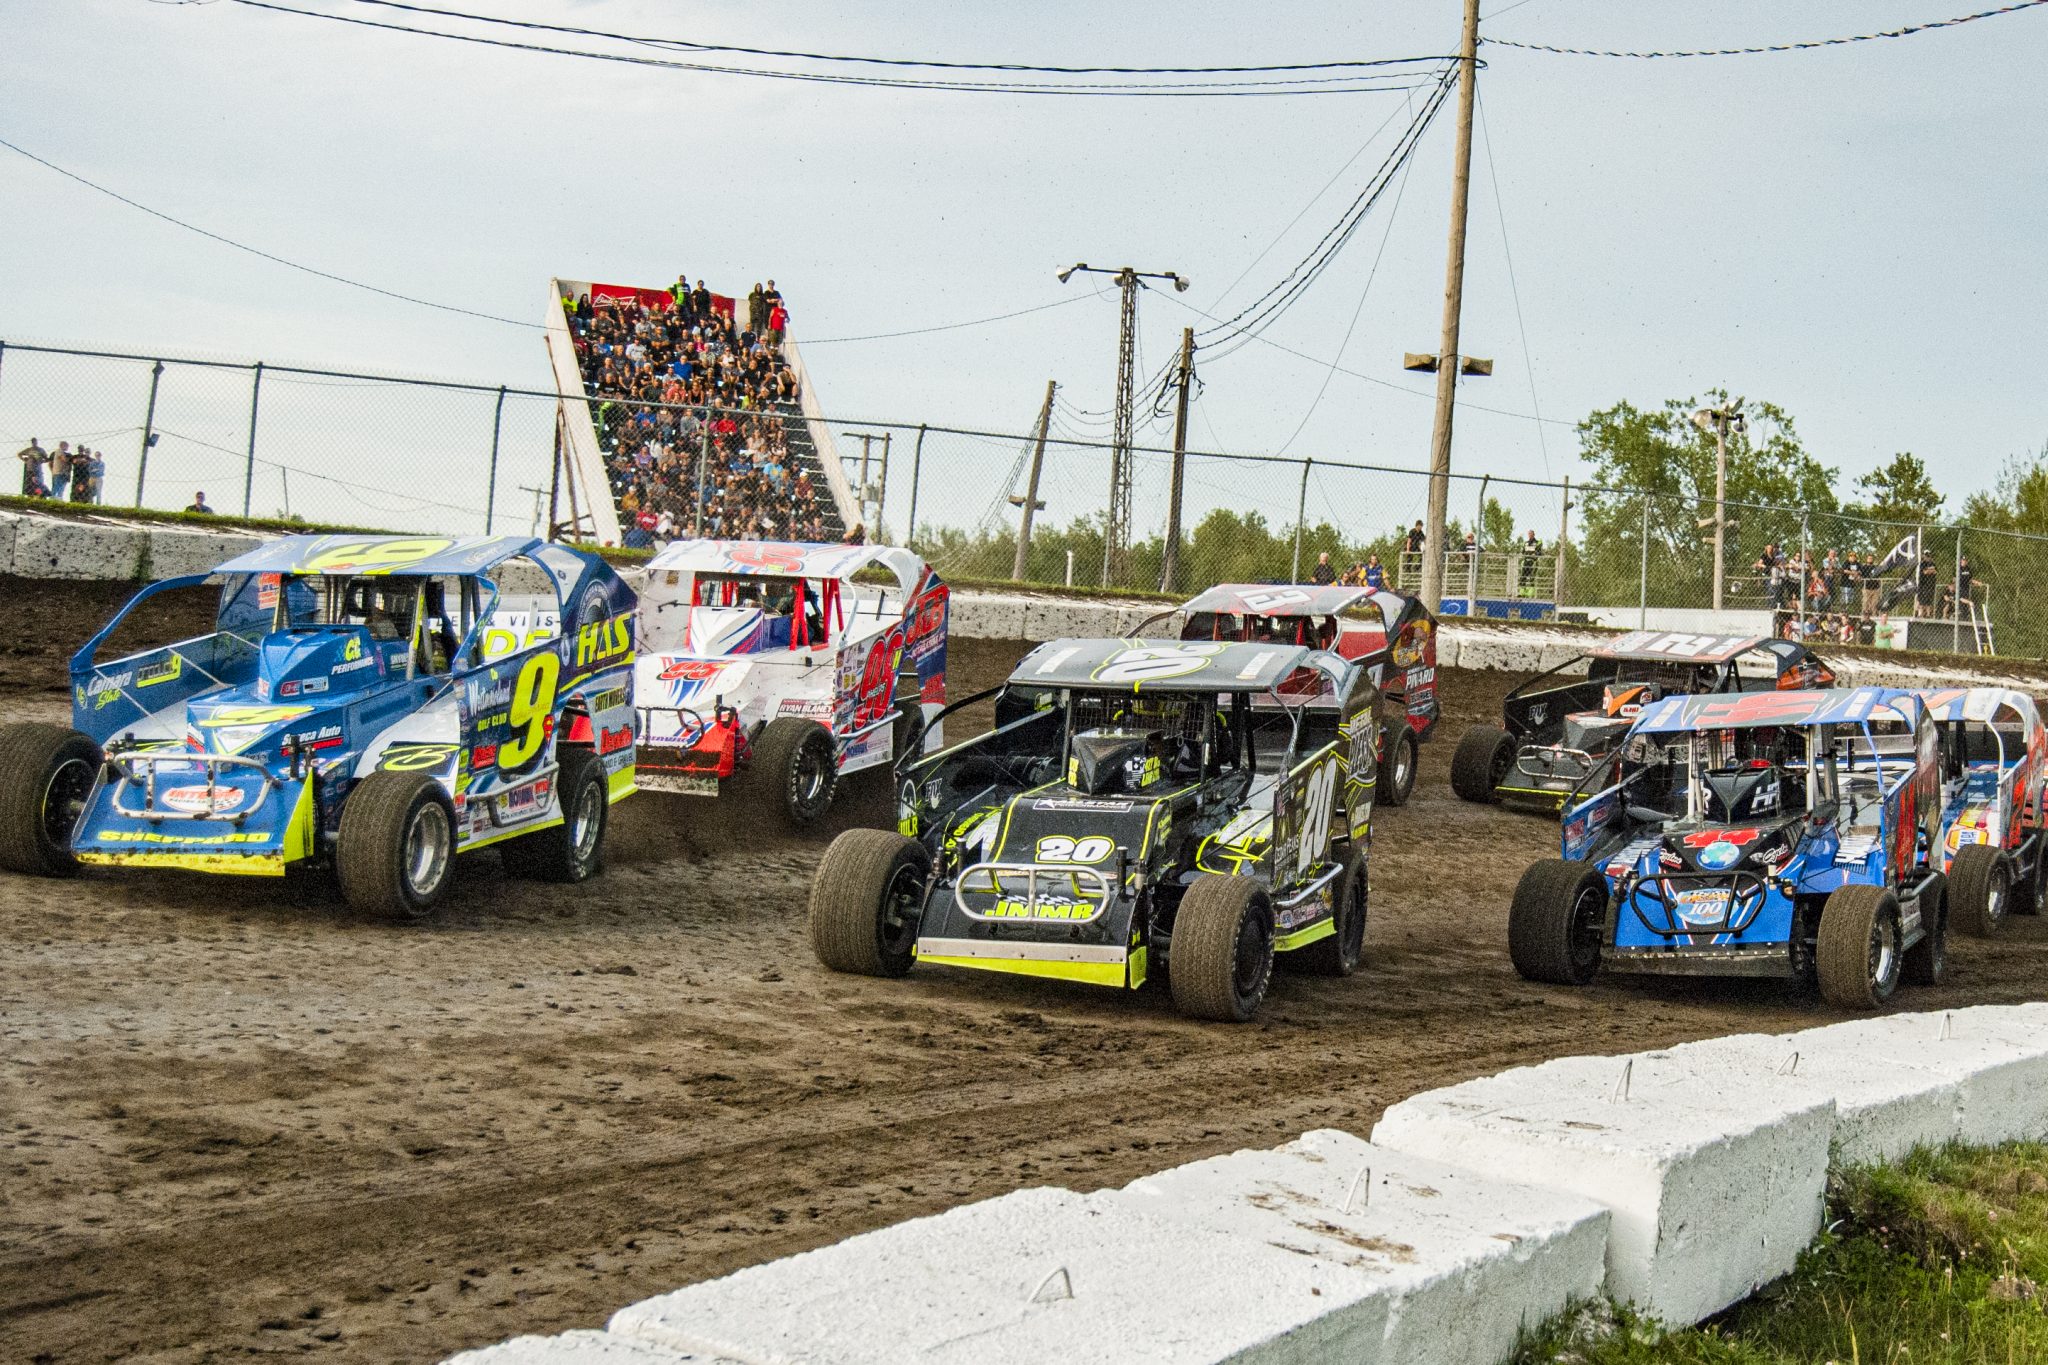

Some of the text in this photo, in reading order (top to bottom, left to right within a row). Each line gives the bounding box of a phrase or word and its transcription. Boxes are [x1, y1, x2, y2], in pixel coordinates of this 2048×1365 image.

[498, 652, 560, 770] 9
[780, 704, 832, 713] RYAN BLANEY
[318, 725, 341, 740] Auto
[99, 831, 272, 843] SHEPPARD
[1037, 836, 1113, 863] 20
[1689, 902, 1723, 914] 100
